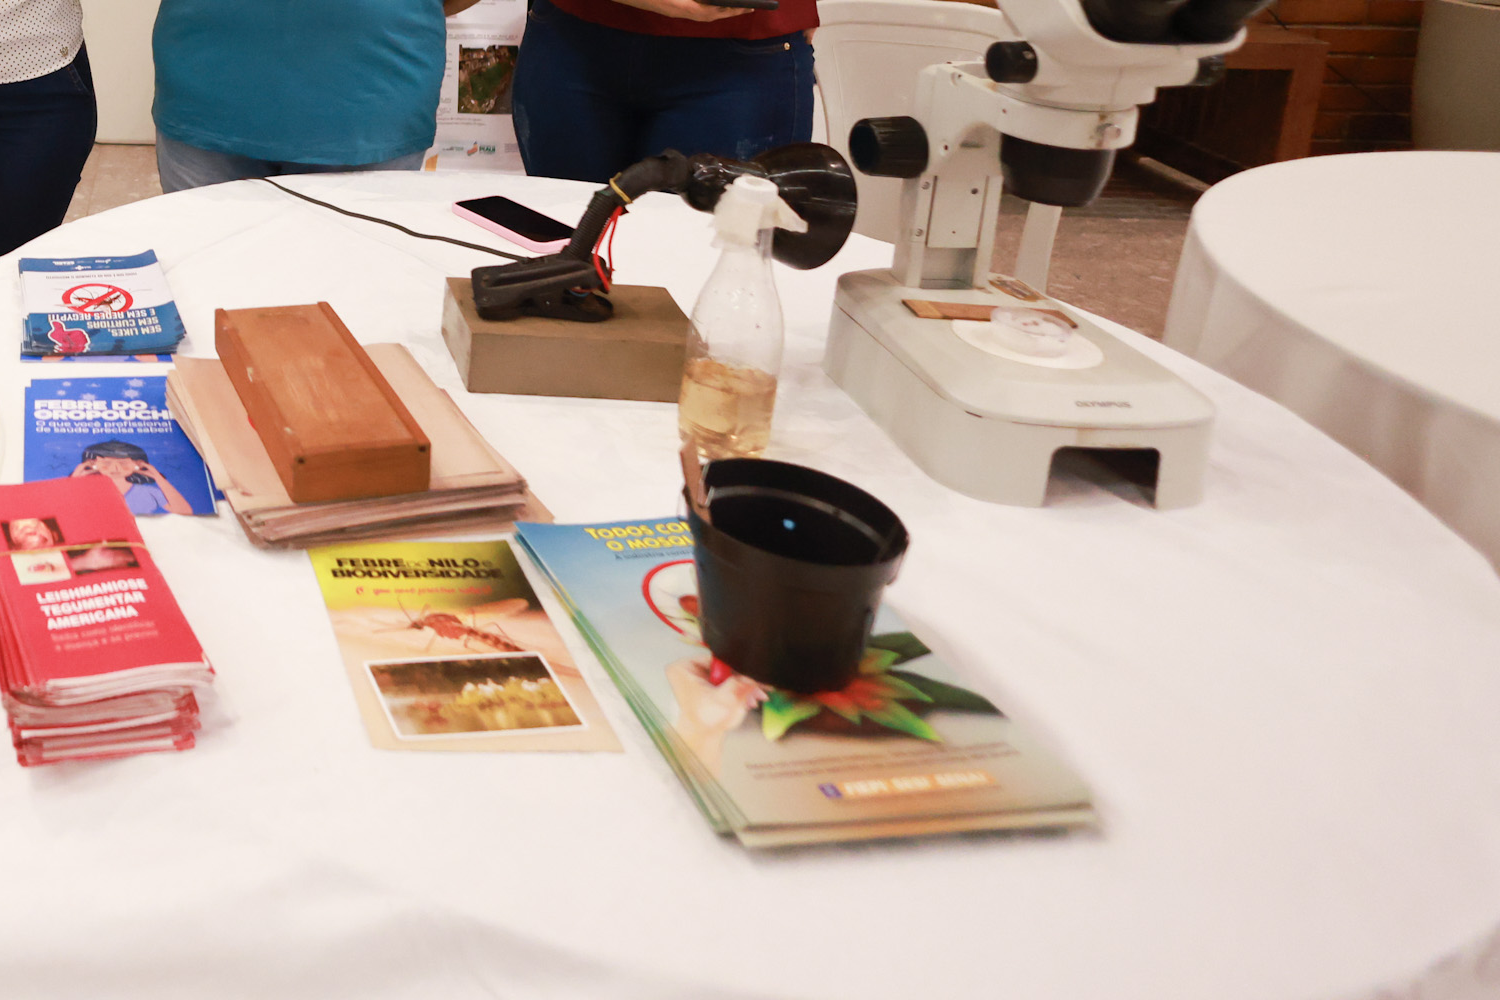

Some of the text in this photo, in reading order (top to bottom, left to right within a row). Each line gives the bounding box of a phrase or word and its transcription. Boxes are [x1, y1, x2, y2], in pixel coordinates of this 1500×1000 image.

[126, 310, 146, 319] SEM
[86, 316, 159, 330] SEM CURTIDAS
[108, 324, 162, 337] SEM LIKES,
[34, 400, 149, 410] FEBRE DO
[36, 420, 46, 428] O
[73, 420, 102, 428] você
[104, 420, 172, 429] profissional
[583, 525, 655, 540] TODOS
[605, 540, 624, 552] O
[336, 558, 406, 568] FEBRE
[428, 558, 481, 568] NILO
[331, 568, 505, 579] BIODIVERSIDADE
[36, 578, 149, 605] LEISHMANIOSE
[40, 591, 147, 618] TEGUMENTAR
[47, 605, 139, 631] AMERICANA
